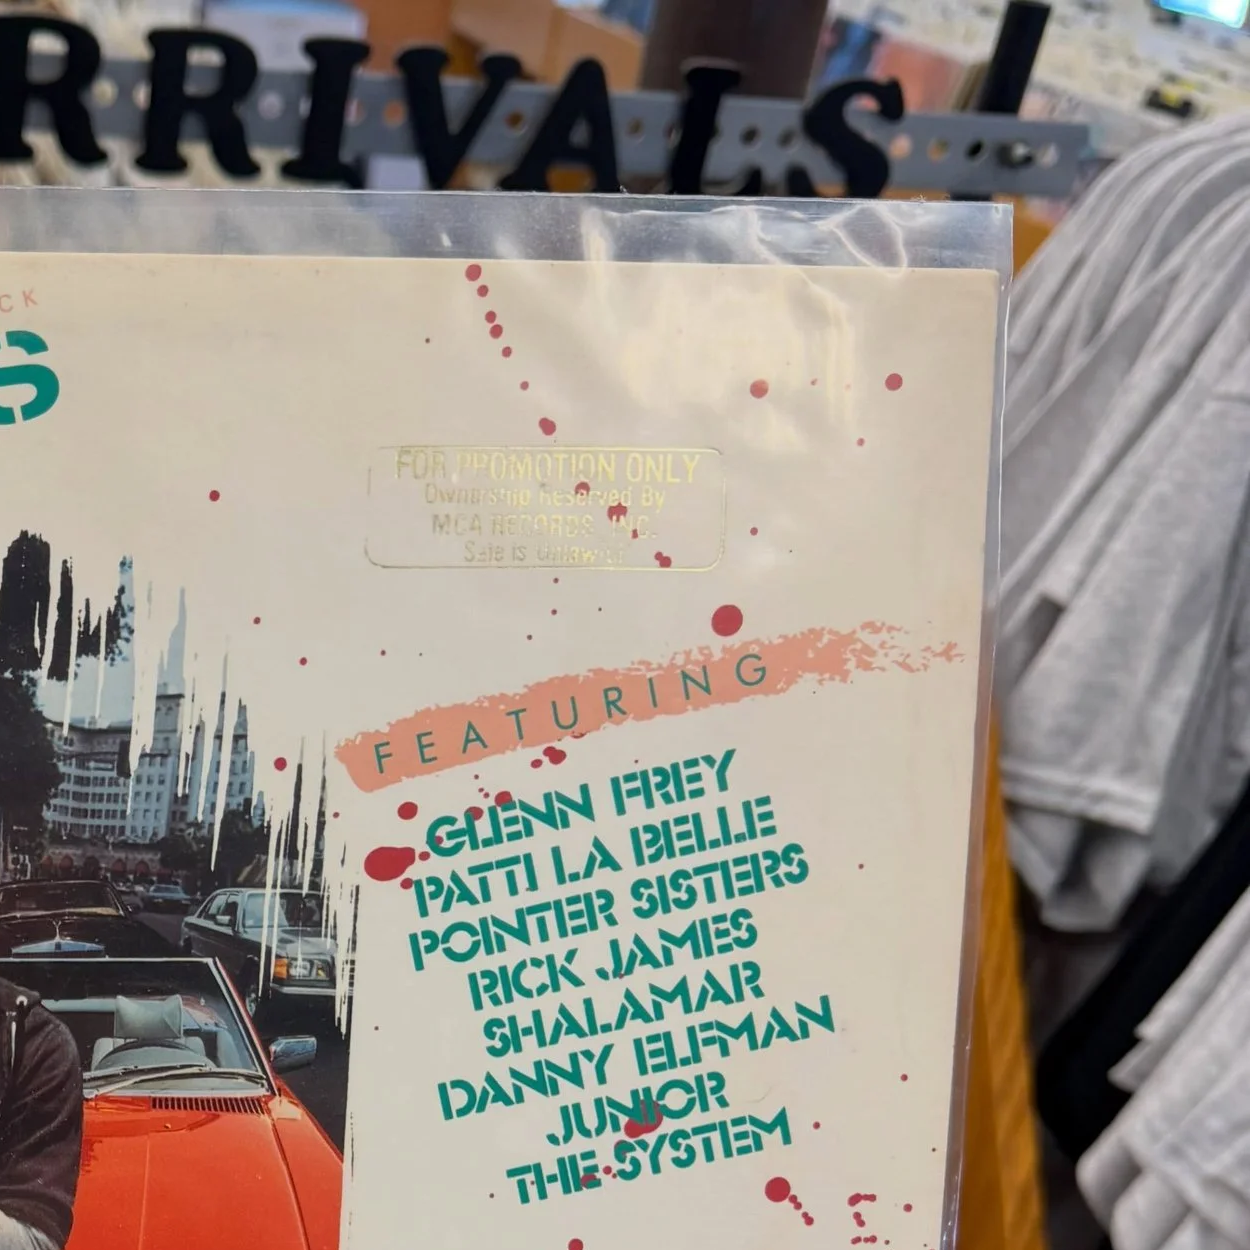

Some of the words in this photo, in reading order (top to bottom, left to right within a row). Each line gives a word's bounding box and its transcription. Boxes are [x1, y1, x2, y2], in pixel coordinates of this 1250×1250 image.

[395, 450, 447, 480] FOR
[456, 451, 616, 483] PROMOTION
[626, 452, 702, 484] ONLY
[425, 483, 532, 506] Ownership
[640, 486, 666, 513] By
[431, 513, 483, 537] MCA
[490, 514, 597, 538] RECORDS
[373, 652, 768, 775] FEATURING
[425, 783, 596, 858] GLENN
[610, 747, 738, 817] FREY
[408, 887, 620, 972] POINTER
[629, 842, 810, 920] SISTERS
[412, 852, 539, 919] PATTI
[551, 835, 623, 886] LA
[629, 794, 778, 868] BELLE
[467, 947, 586, 1012] RICK
[594, 907, 759, 982] JAMES
[482, 960, 766, 1059] SHALAMAR
[437, 1042, 616, 1121] DANNY
[632, 994, 836, 1077] ELFMAN
[545, 1070, 731, 1147] JUNIOR
[505, 1149, 603, 1206] THE
[613, 1105, 793, 1182] SYSTEM
